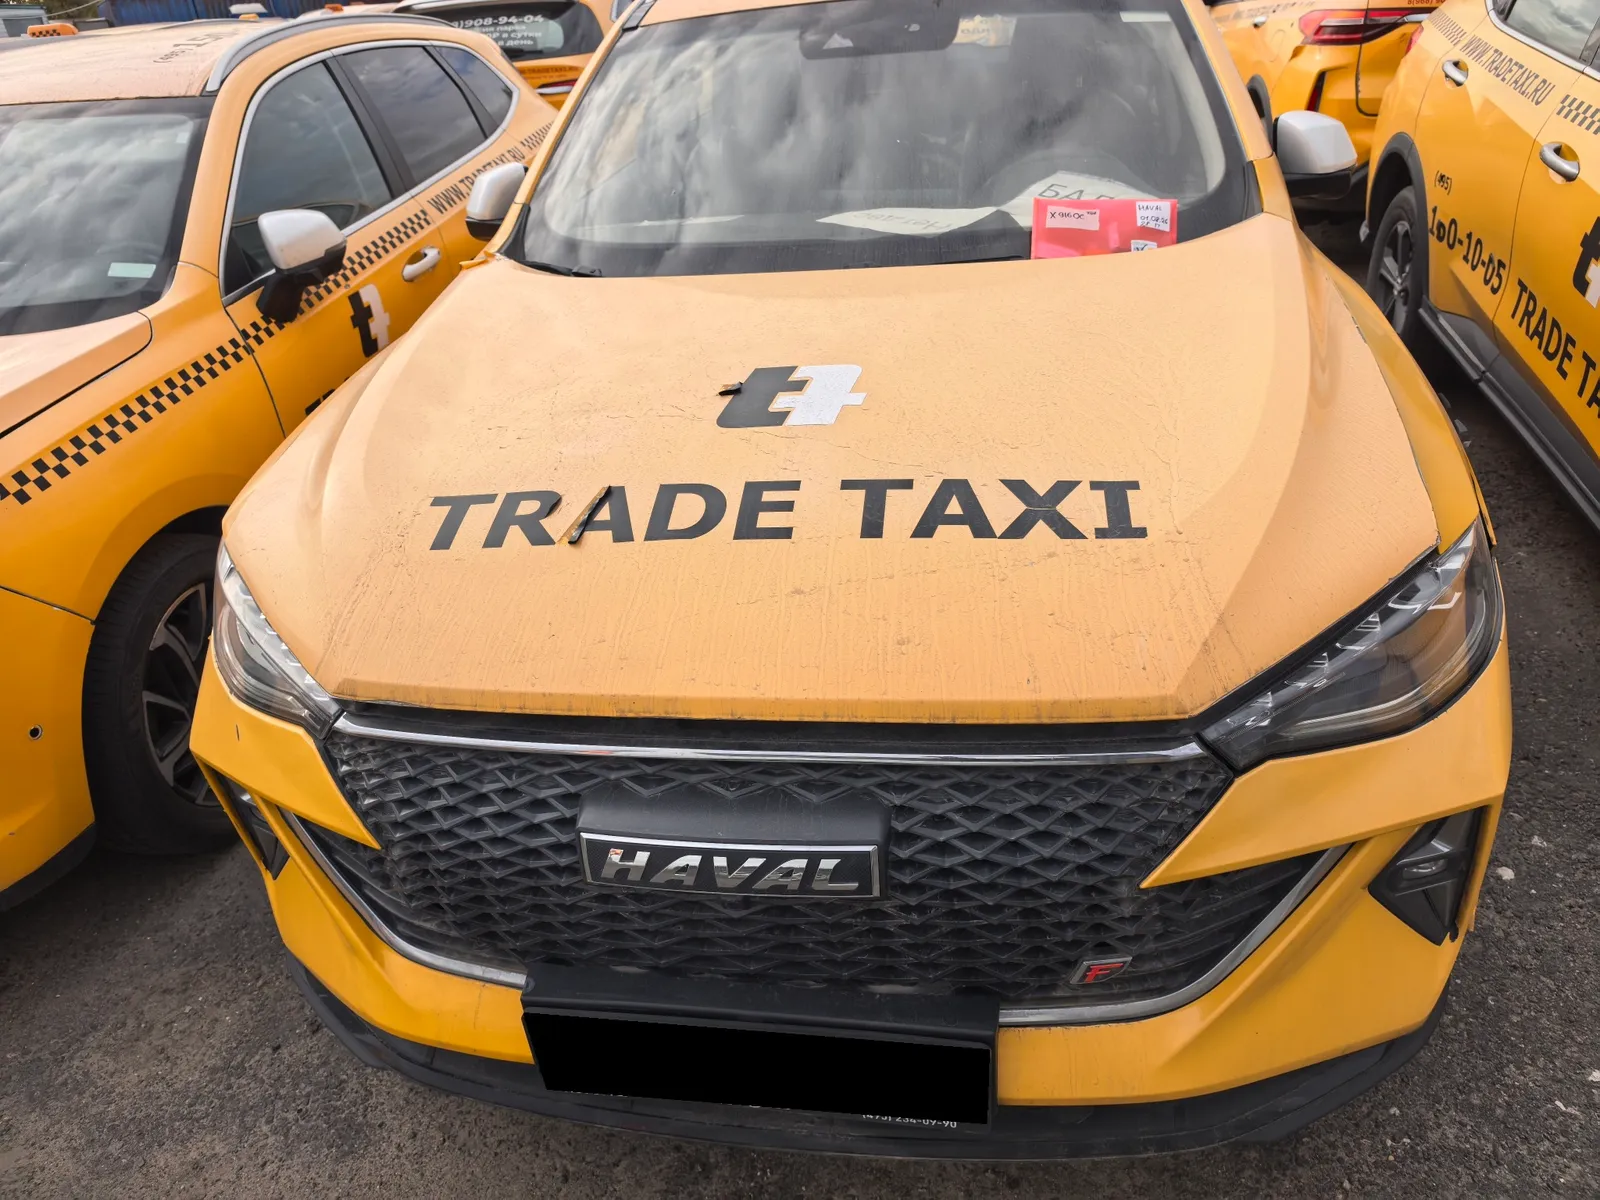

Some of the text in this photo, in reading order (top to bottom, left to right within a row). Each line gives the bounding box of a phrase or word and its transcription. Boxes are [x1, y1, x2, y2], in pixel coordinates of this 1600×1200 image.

[506, 39, 534, 47] день
[1459, 34, 1556, 107] WWW.TRADETAXI.RU
[1510, 277, 1577, 381] TRADE
[428, 478, 1149, 551] TRADE TAXI
[600, 847, 860, 891] HAVAL
